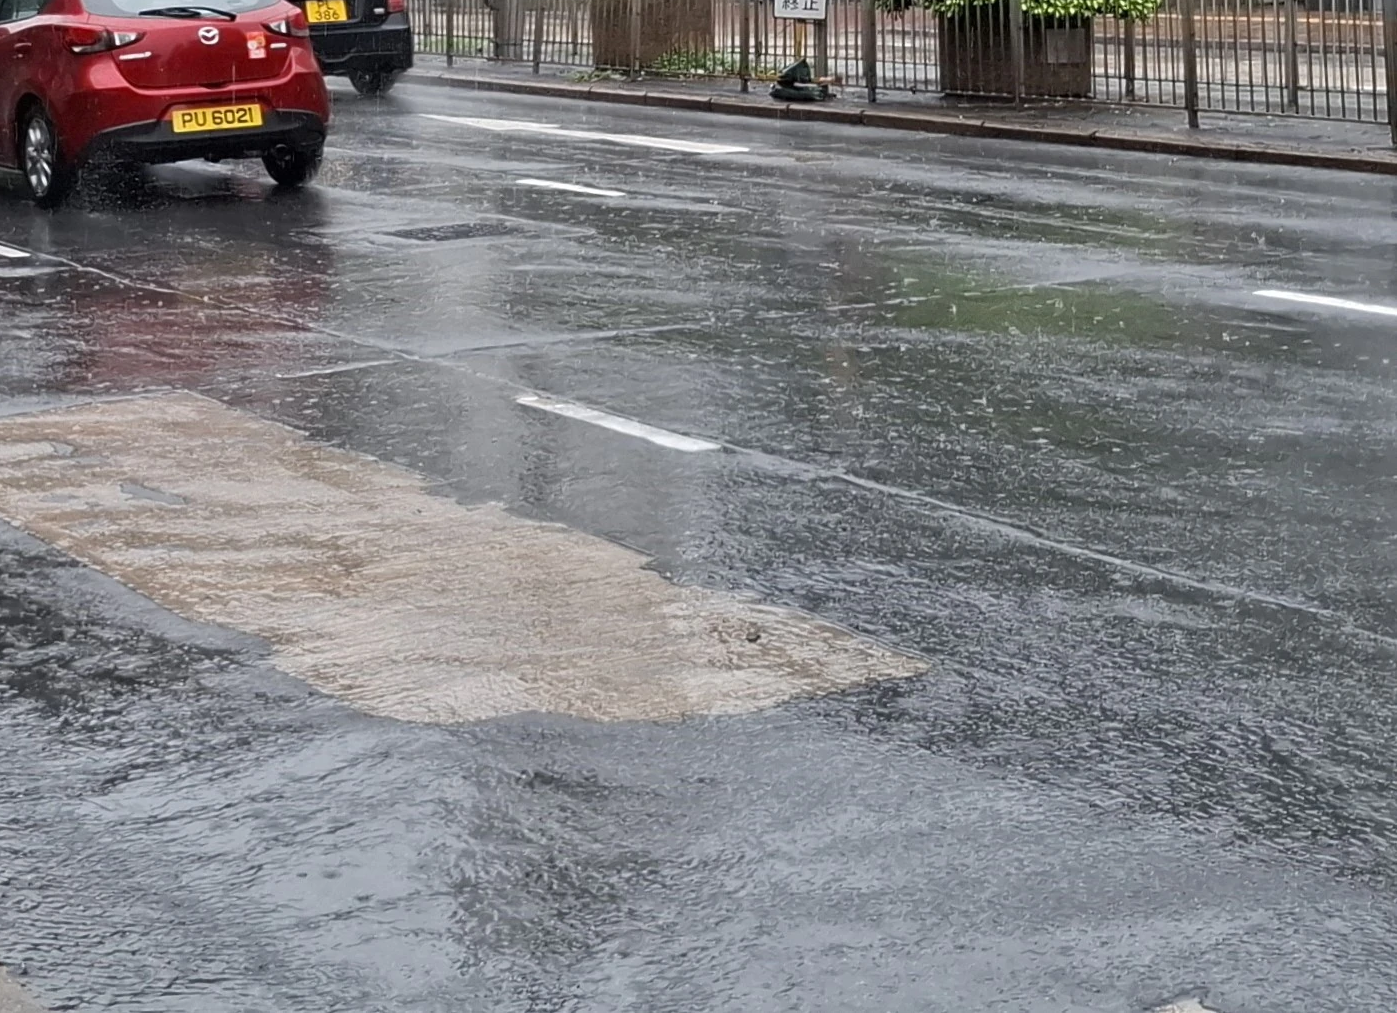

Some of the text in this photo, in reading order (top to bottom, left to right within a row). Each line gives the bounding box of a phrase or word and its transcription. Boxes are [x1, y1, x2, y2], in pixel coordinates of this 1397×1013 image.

[315, 10, 340, 20] 386
[182, 107, 254, 128] PU 6021
